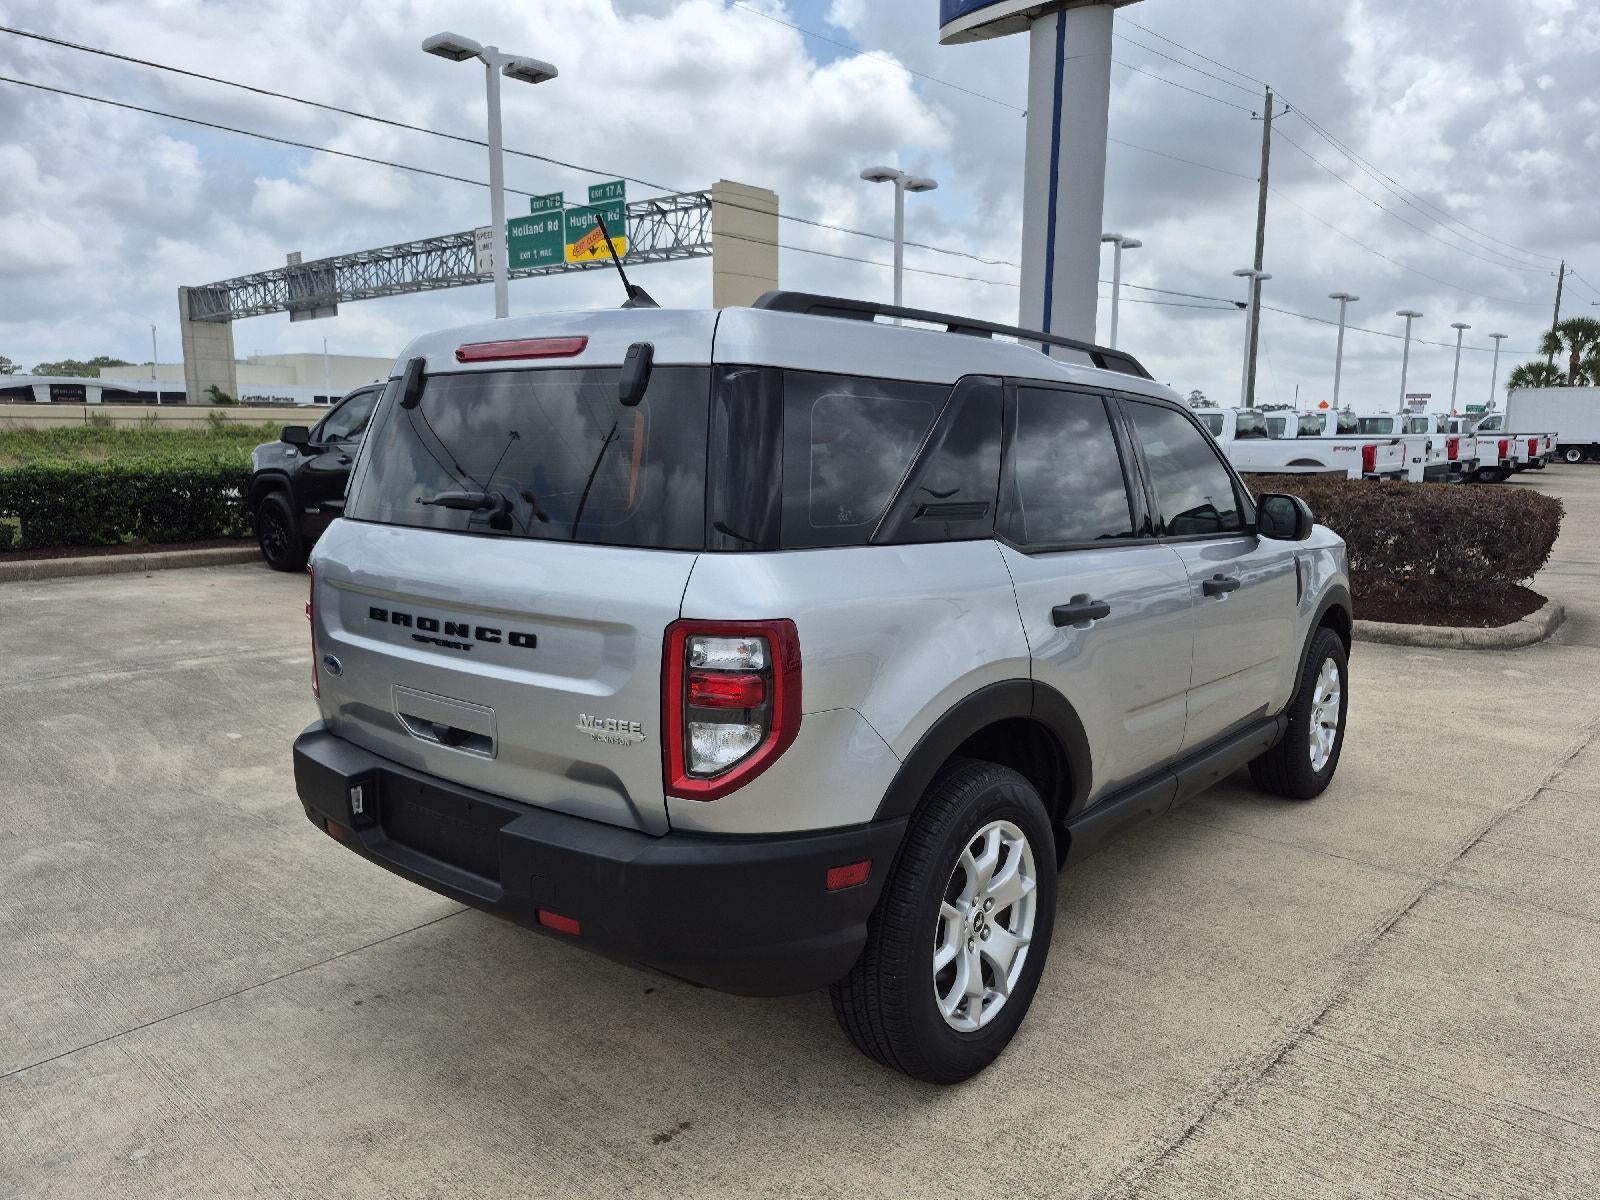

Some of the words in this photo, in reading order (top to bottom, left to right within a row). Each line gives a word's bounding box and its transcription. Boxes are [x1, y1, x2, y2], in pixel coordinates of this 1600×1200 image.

[591, 189, 603, 199] EXIT
[605, 185, 614, 197] 17
[616, 184, 623, 196] A
[533, 200, 545, 209] EXIT
[607, 208, 620, 222] Rd
[512, 222, 544, 238] Holland
[547, 219, 559, 232] Rd
[520, 250, 531, 260] EXIT
[533, 249, 538, 259] 1
[540, 248, 552, 257] MILE
[242, 394, 270, 402] Certified
[271, 394, 295, 402] Service
[369, 606, 538, 649] BRONCO
[411, 633, 474, 651] SPORT
